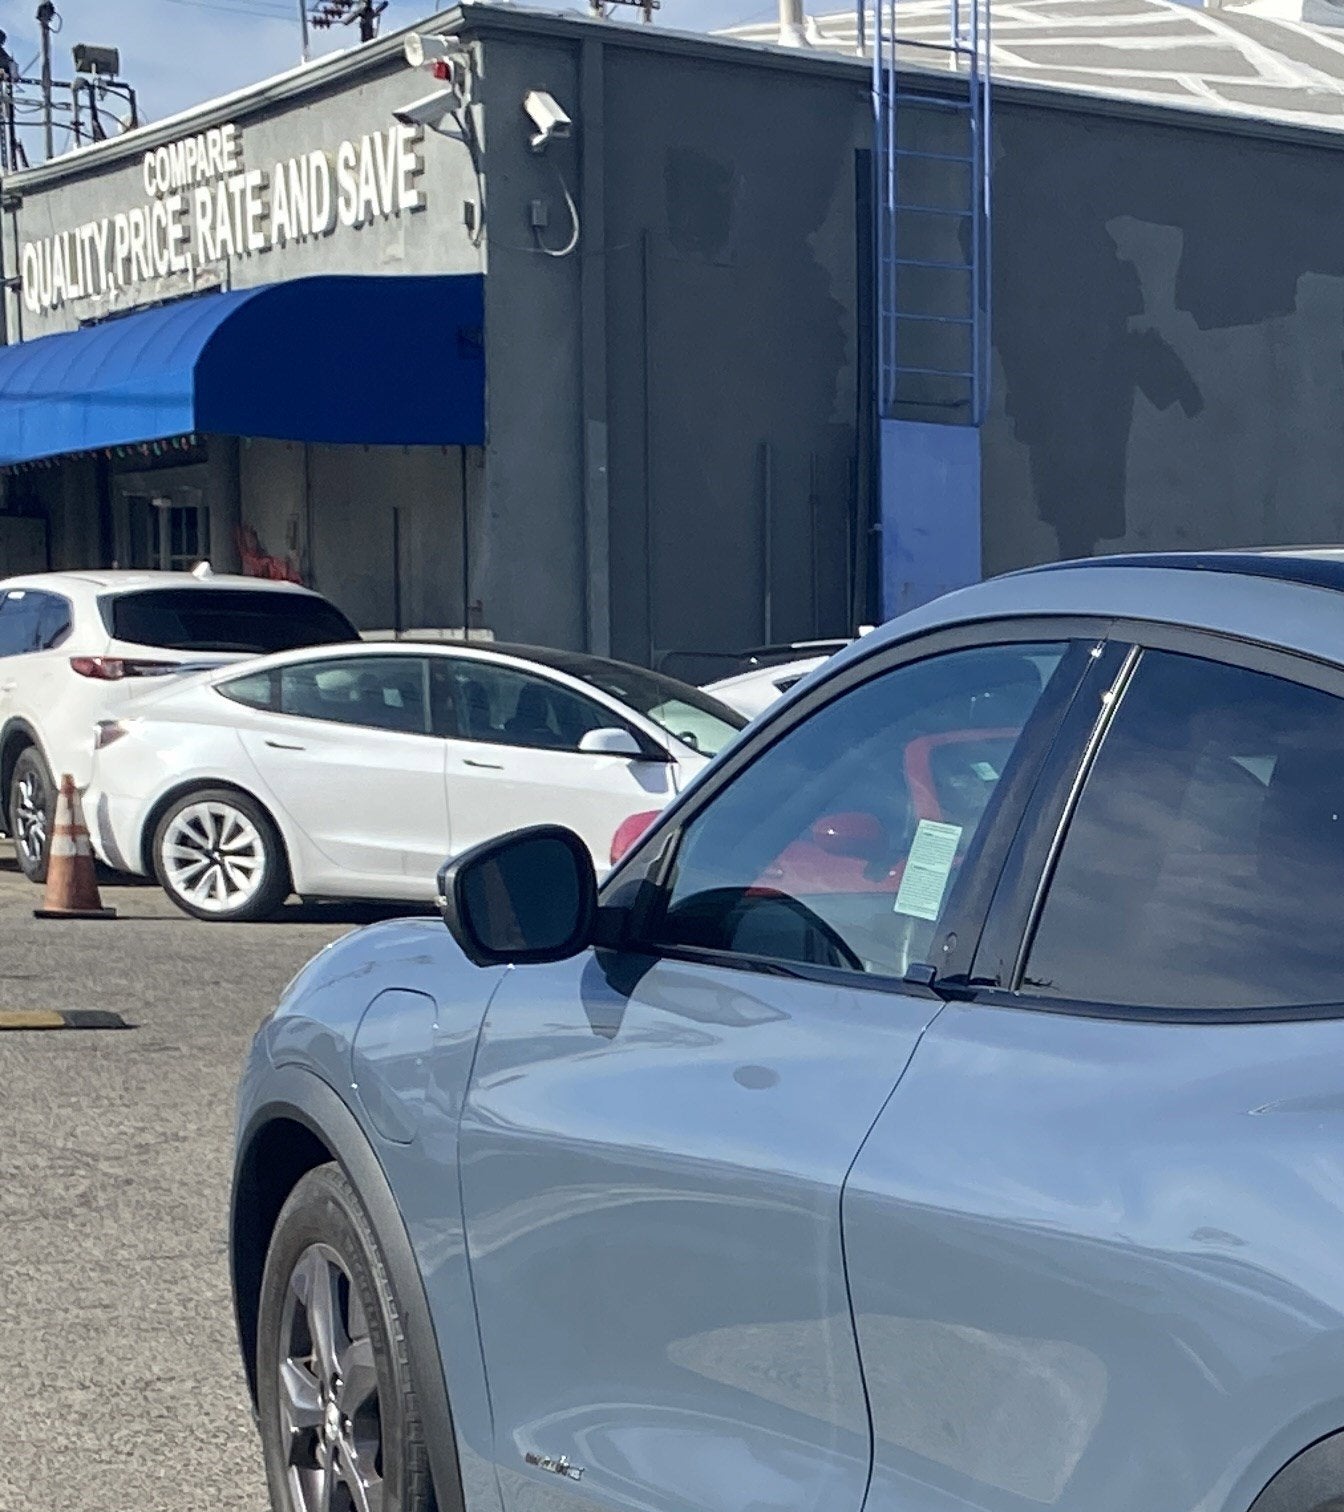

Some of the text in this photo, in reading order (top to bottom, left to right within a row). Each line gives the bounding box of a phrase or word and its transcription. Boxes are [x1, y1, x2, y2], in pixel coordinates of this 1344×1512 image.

[144, 123, 238, 196] COMPARE
[196, 170, 266, 264] RATE
[271, 149, 331, 244] AND
[337, 126, 420, 227] SAVE
